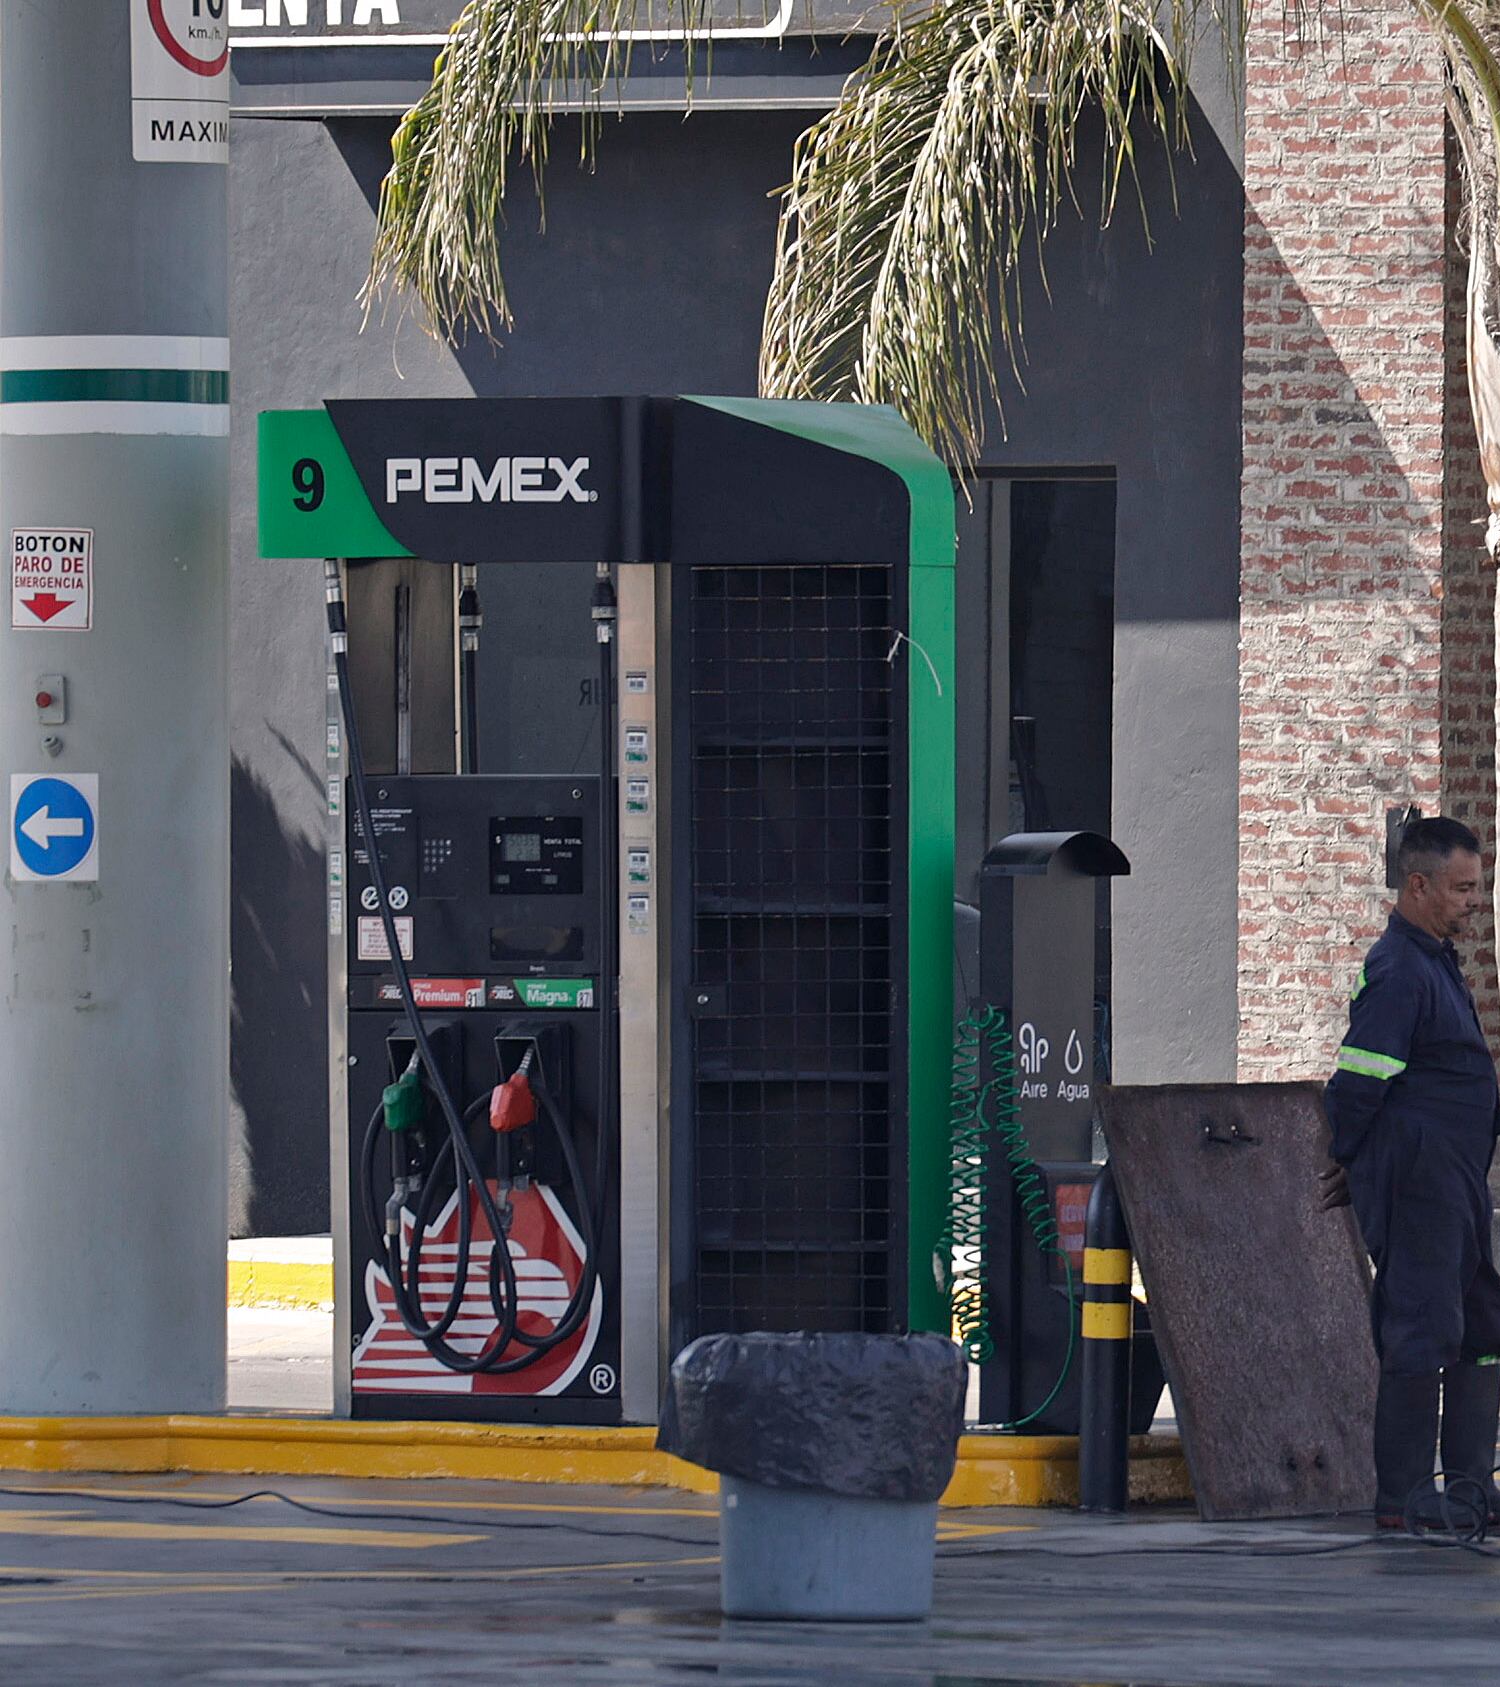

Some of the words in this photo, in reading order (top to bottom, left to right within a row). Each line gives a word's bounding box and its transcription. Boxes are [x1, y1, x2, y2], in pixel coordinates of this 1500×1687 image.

[292, 458, 325, 512] 9
[15, 536, 84, 553] BOTON
[15, 556, 52, 572] PARO
[61, 557, 84, 573] DE
[15, 576, 84, 589] EMERGENCIA
[413, 988, 461, 1003] Premium
[527, 989, 569, 1006] Magna
[1020, 1080, 1048, 1099] Aire
[1057, 1080, 1090, 1102] Agua
